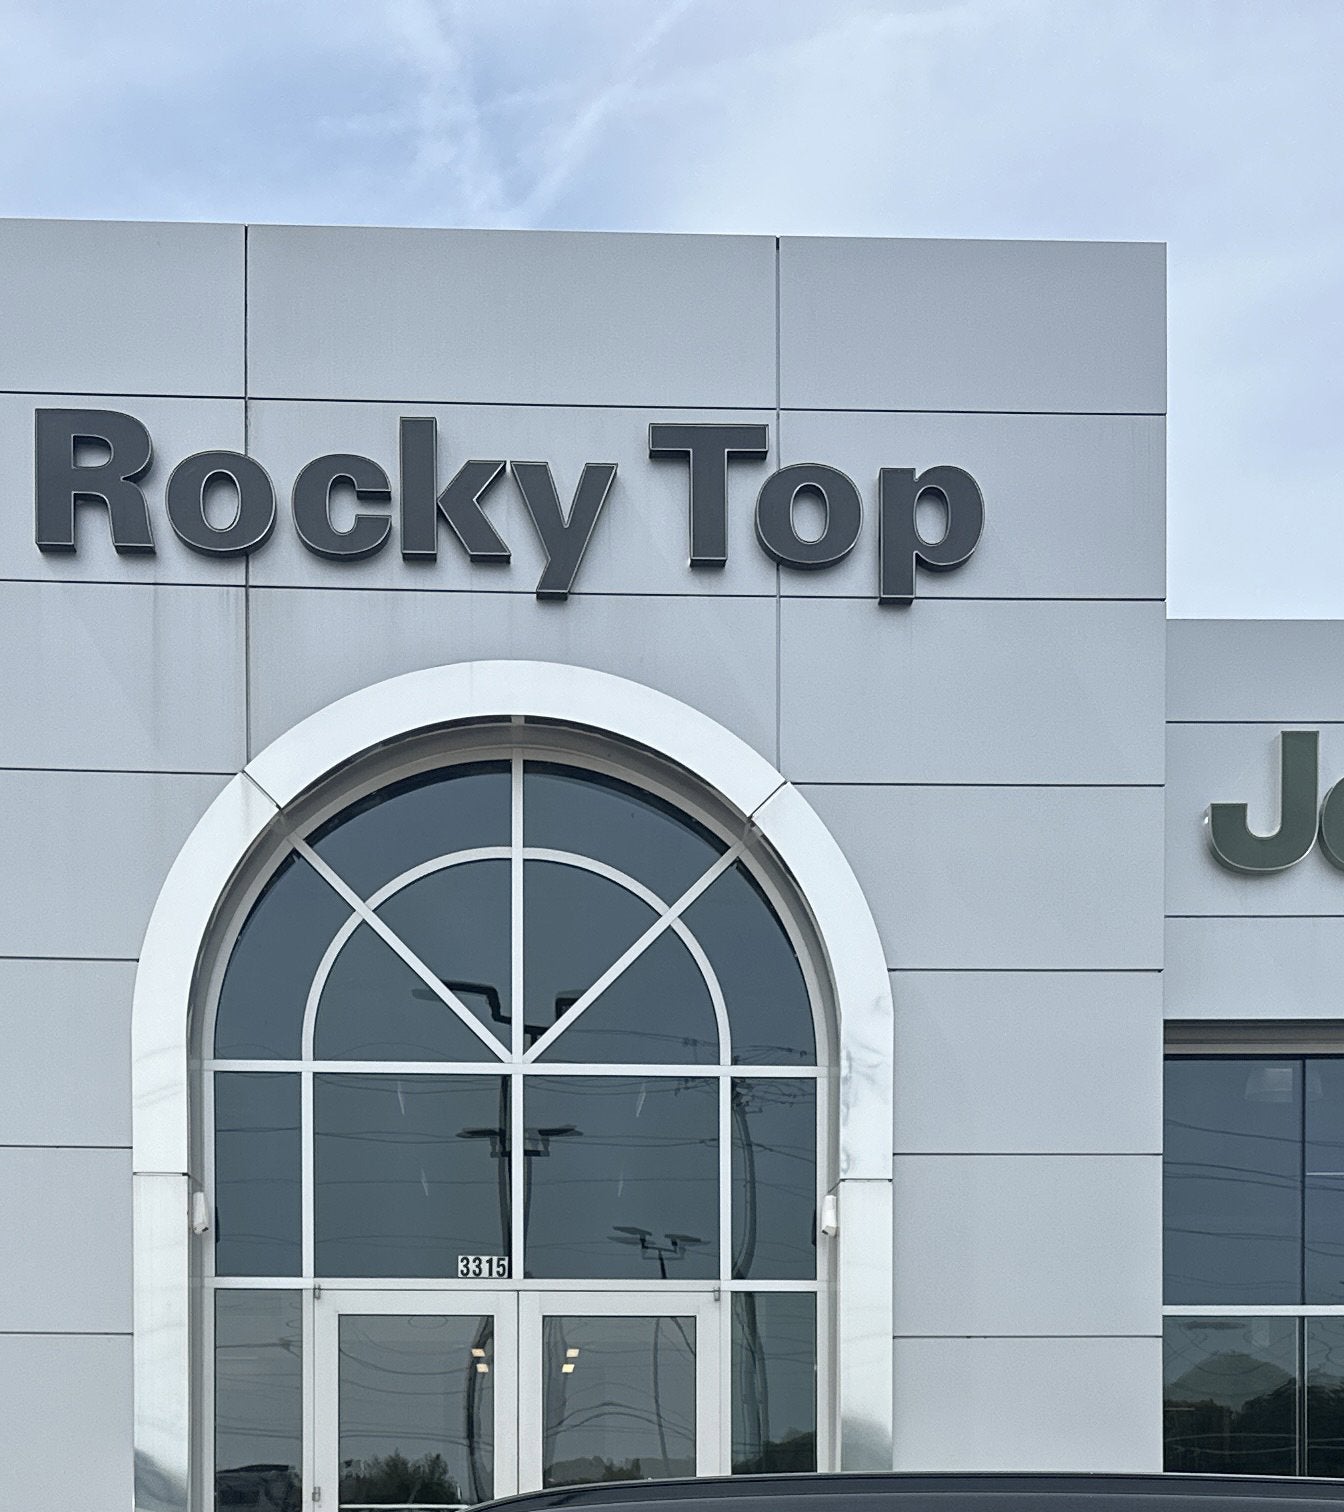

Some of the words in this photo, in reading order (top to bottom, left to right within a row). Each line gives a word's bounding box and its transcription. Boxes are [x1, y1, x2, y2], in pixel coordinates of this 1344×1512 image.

[35, 408, 618, 601] Rocky
[648, 423, 986, 605] Top
[459, 1256, 507, 1277] 3315
